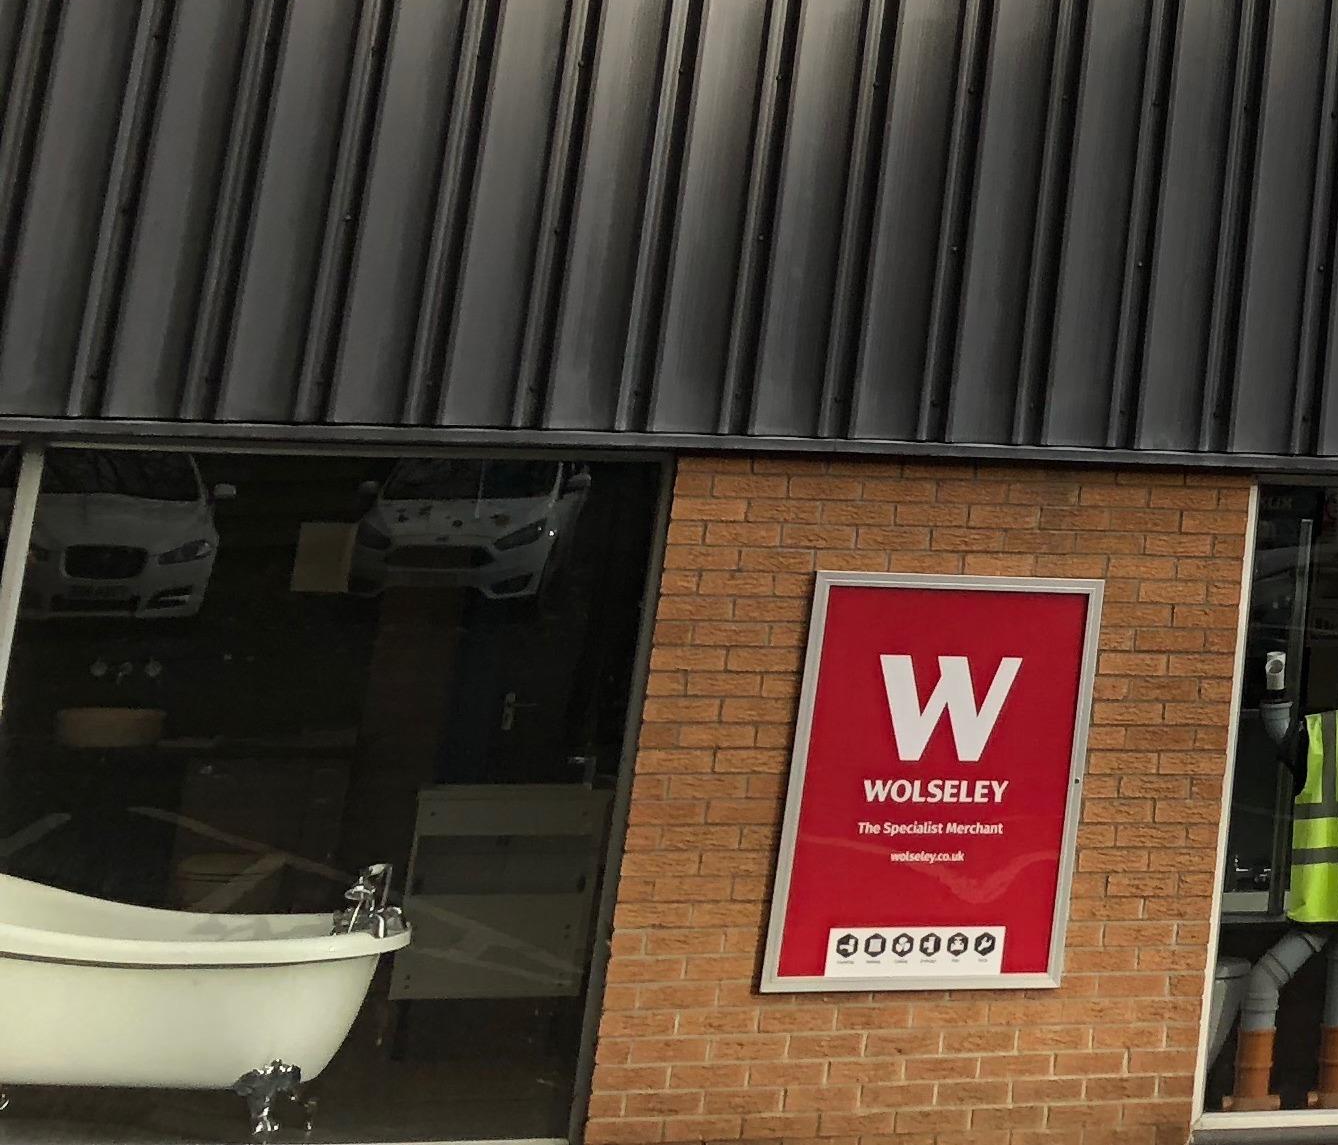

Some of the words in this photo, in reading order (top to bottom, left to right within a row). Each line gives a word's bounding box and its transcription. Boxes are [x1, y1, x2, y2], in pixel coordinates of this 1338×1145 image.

[880, 655, 1023, 762] W
[864, 779, 1009, 803] WOLSELEY
[858, 822, 881, 834] The
[883, 821, 943, 836] Specialist
[945, 822, 1003, 835] Merchant
[891, 851, 965, 864] wolseley.co.uk
